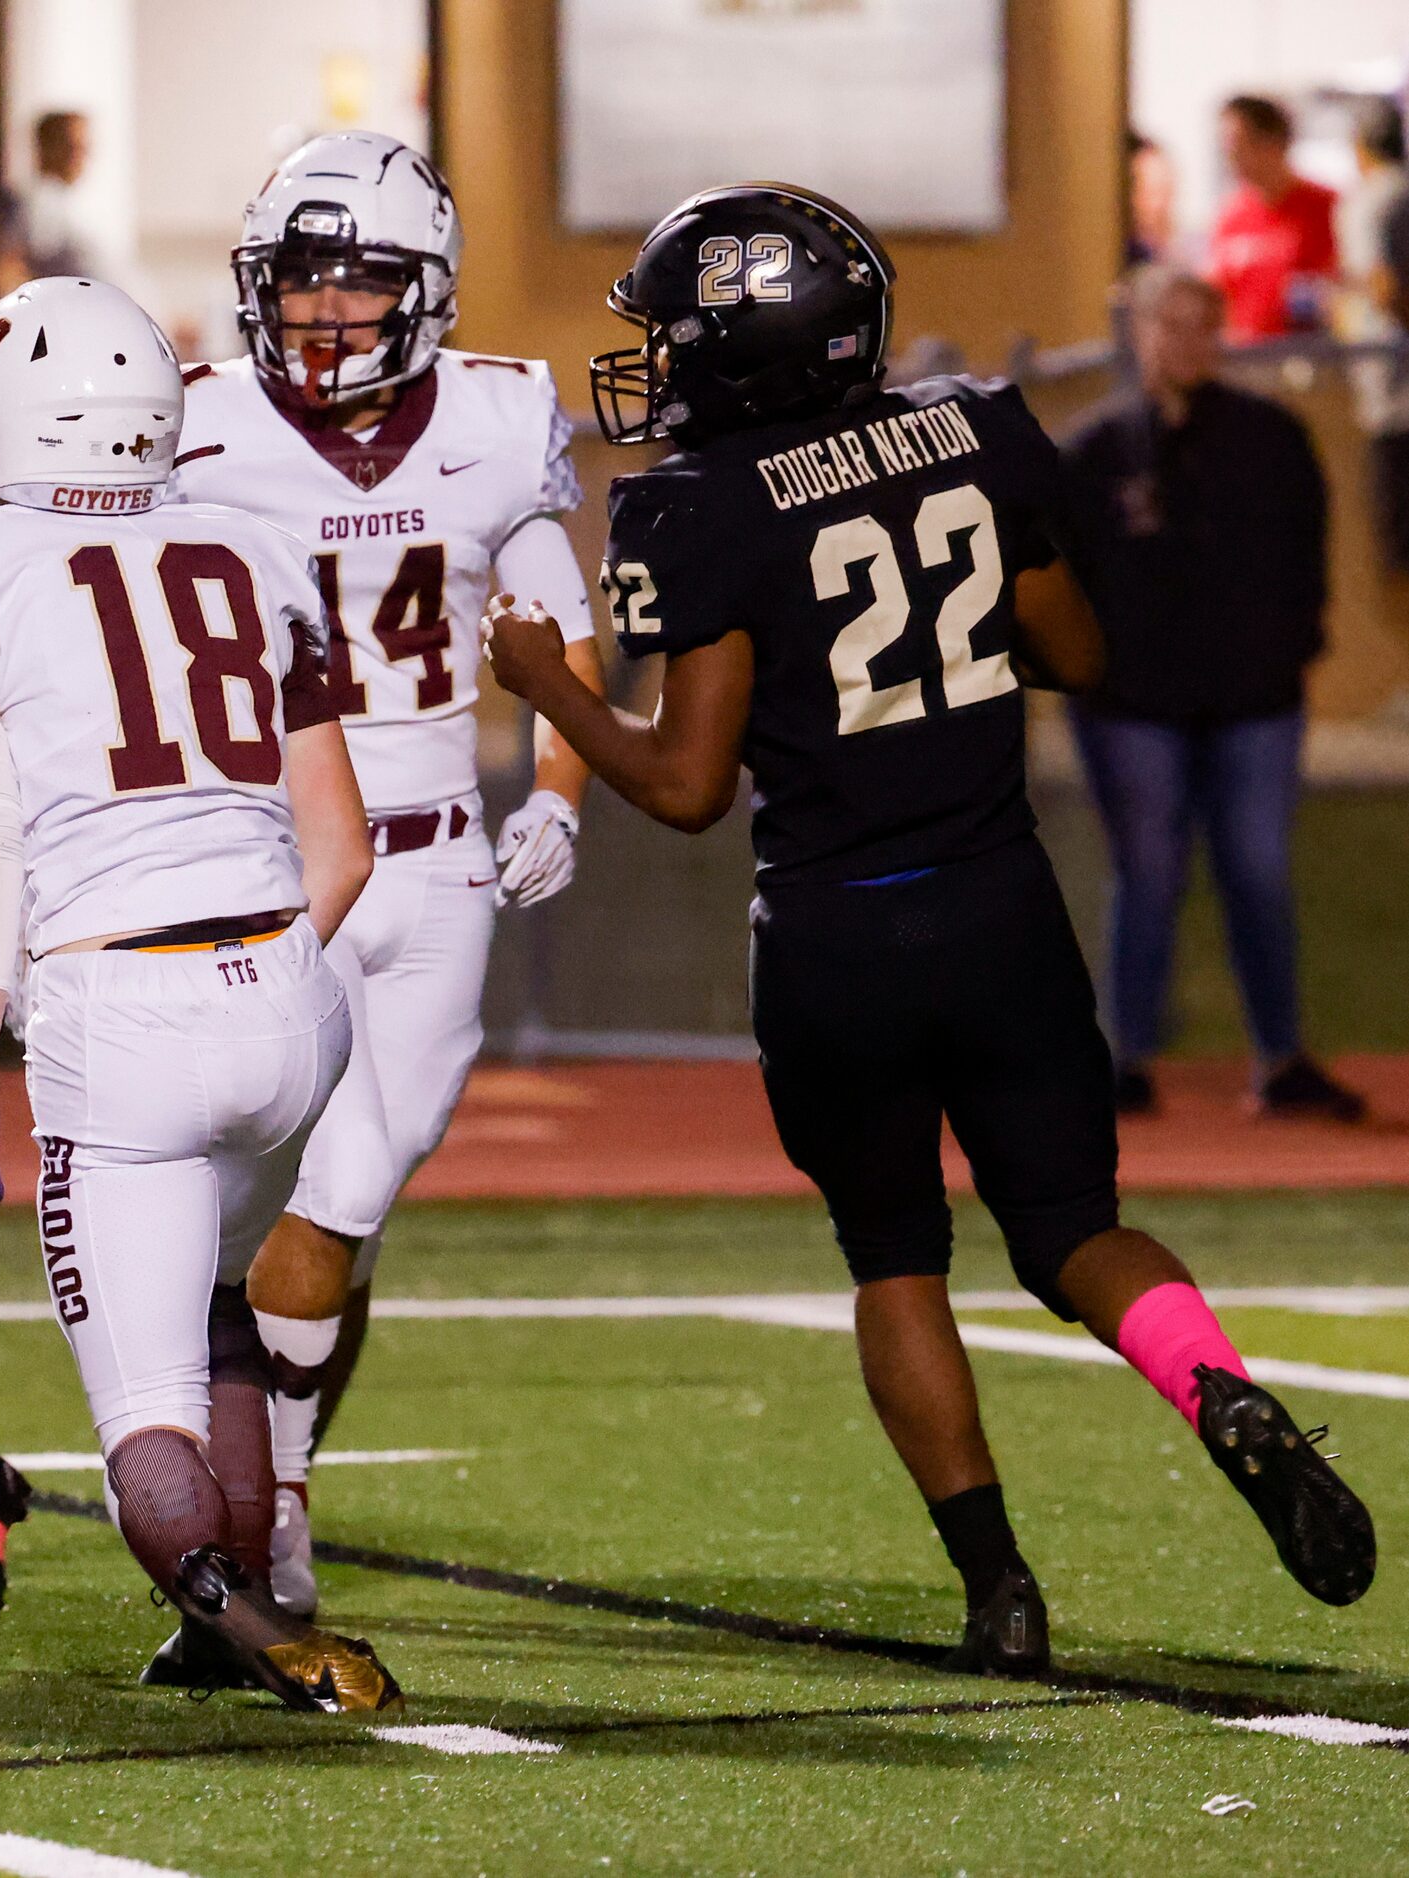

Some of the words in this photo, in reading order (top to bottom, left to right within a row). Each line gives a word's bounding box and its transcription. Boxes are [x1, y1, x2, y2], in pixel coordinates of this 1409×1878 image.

[698, 234, 792, 307] 22
[52, 486, 153, 511] COYOTES
[757, 430, 878, 511] COUGAR
[866, 400, 981, 476] NATION
[321, 509, 425, 540] COYOTES
[314, 541, 453, 718] 14
[599, 556, 662, 634] 22
[809, 483, 1019, 736] 22
[64, 540, 283, 798] 18
